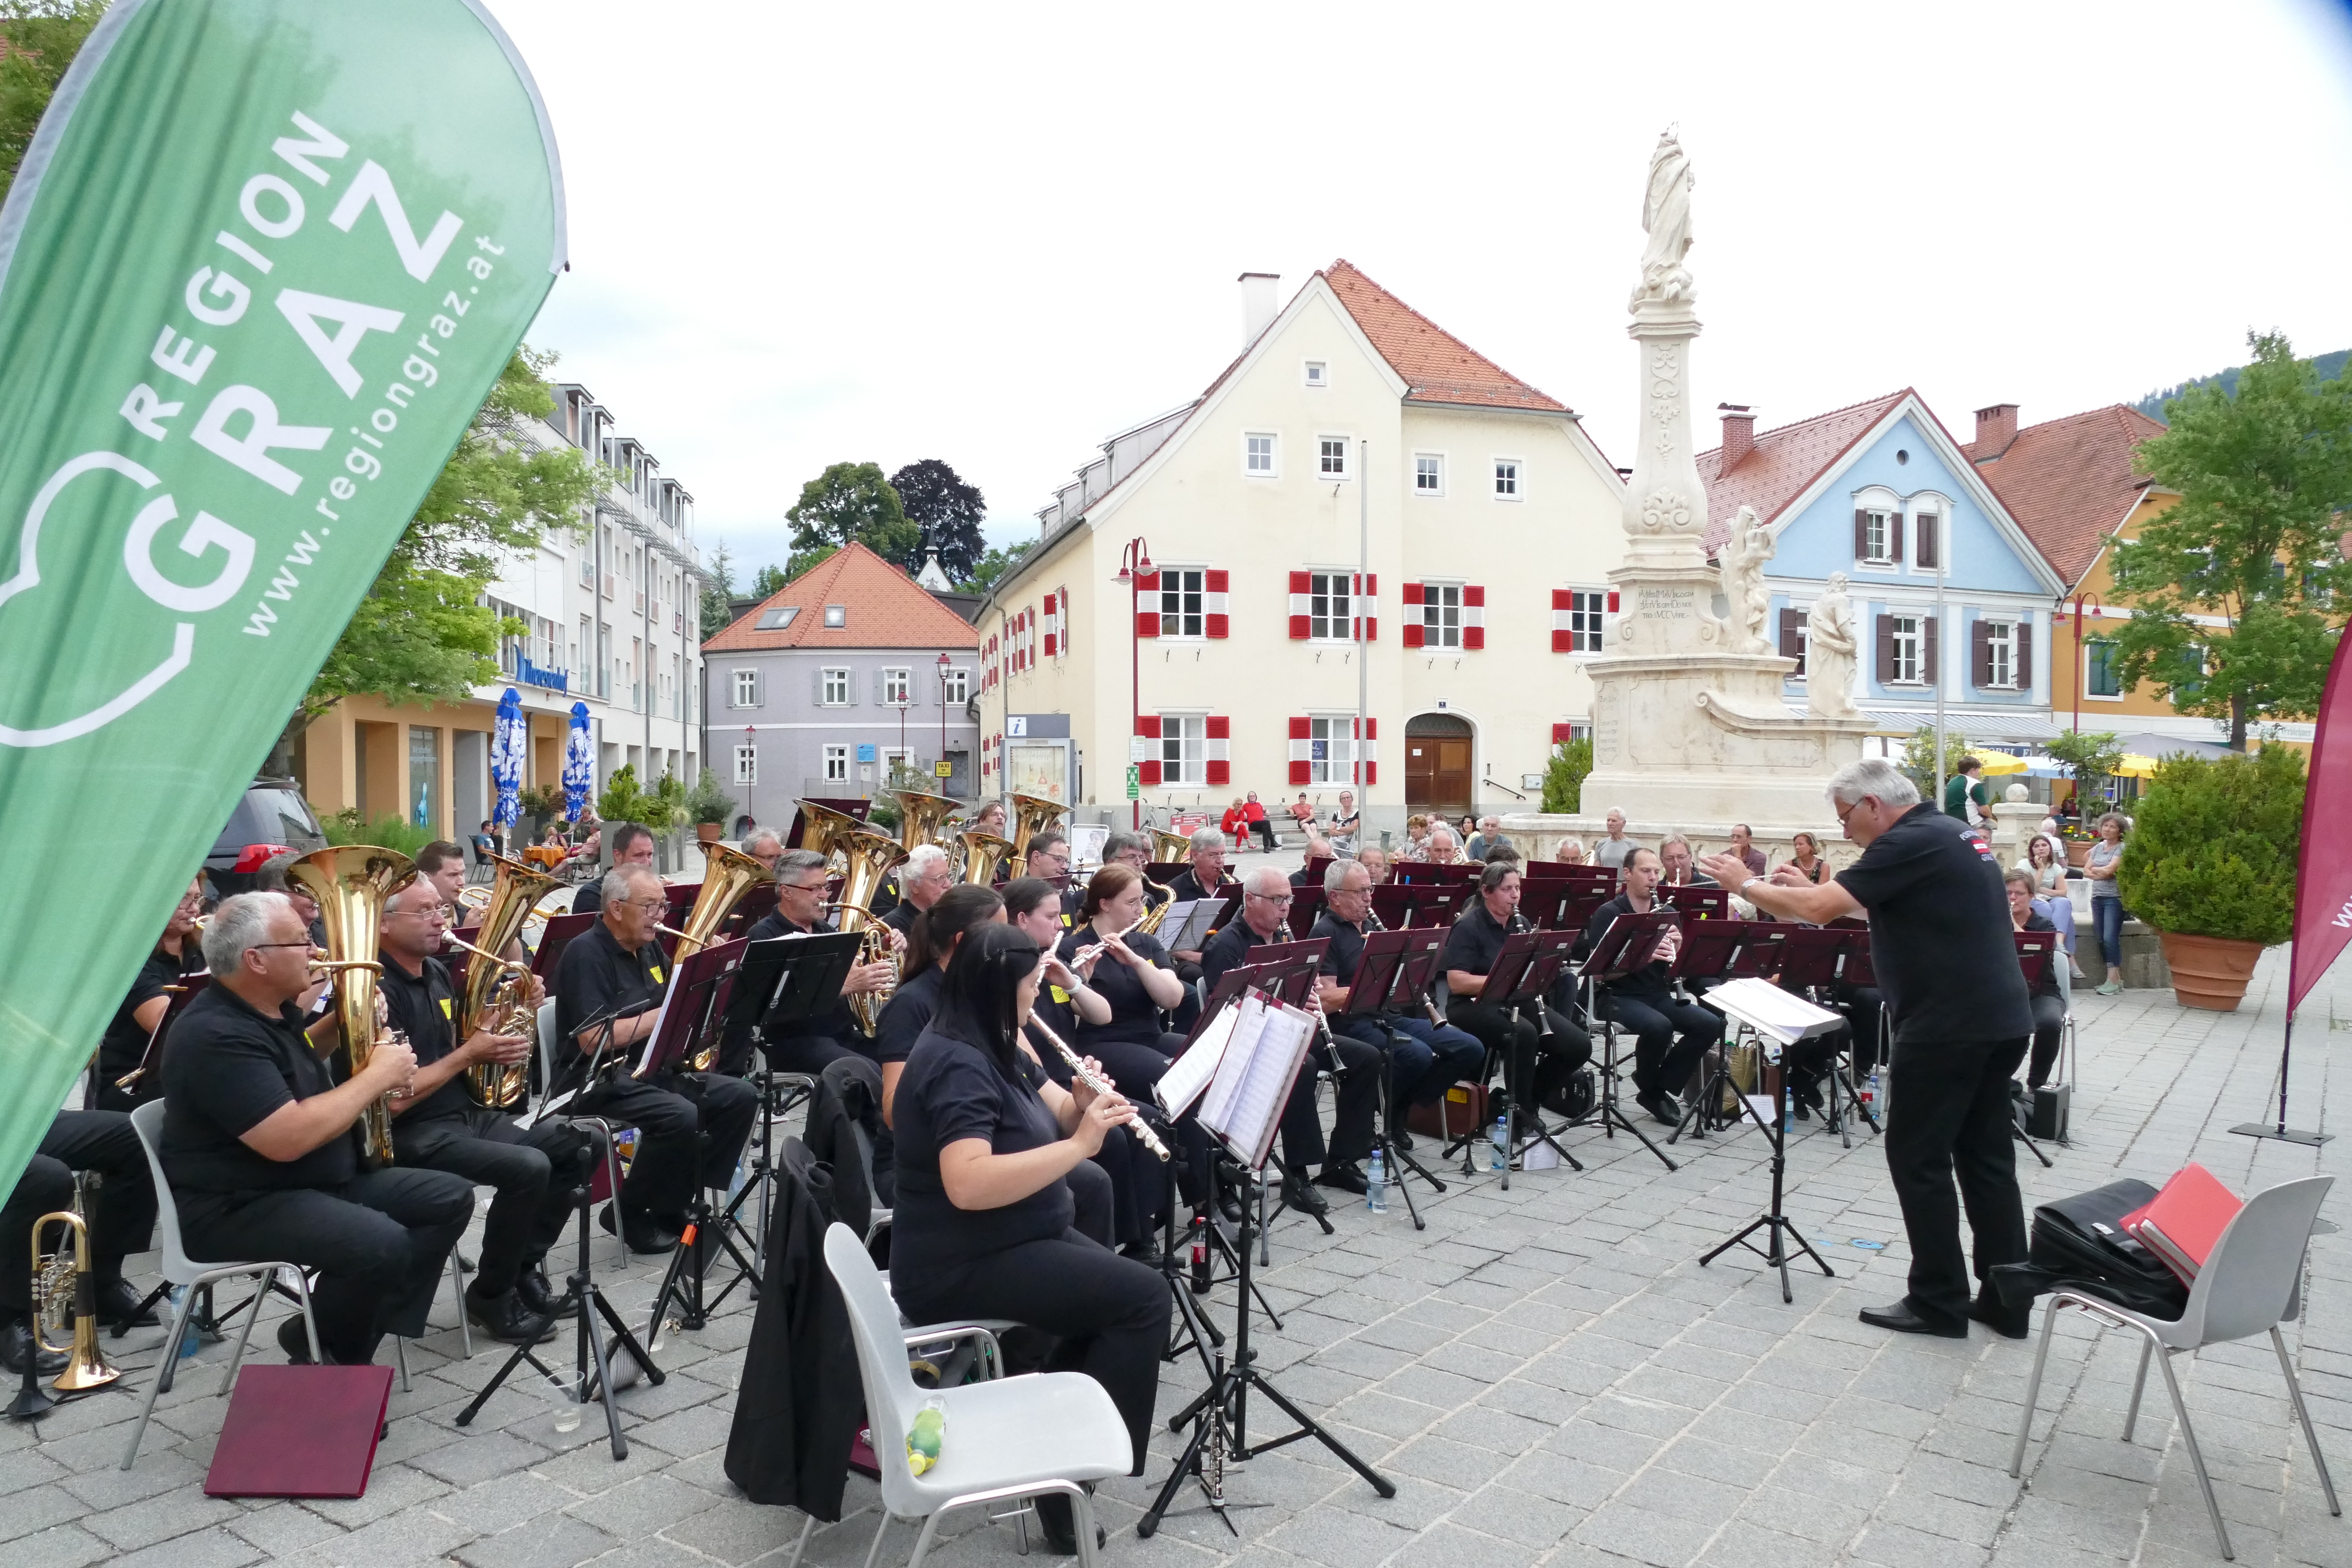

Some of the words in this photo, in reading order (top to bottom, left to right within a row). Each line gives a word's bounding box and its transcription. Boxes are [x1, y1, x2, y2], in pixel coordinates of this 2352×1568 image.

[118, 110, 350, 442] REGION
[123, 159, 463, 612] GRAZ
[242, 233, 505, 638] www.regiongraz.at
